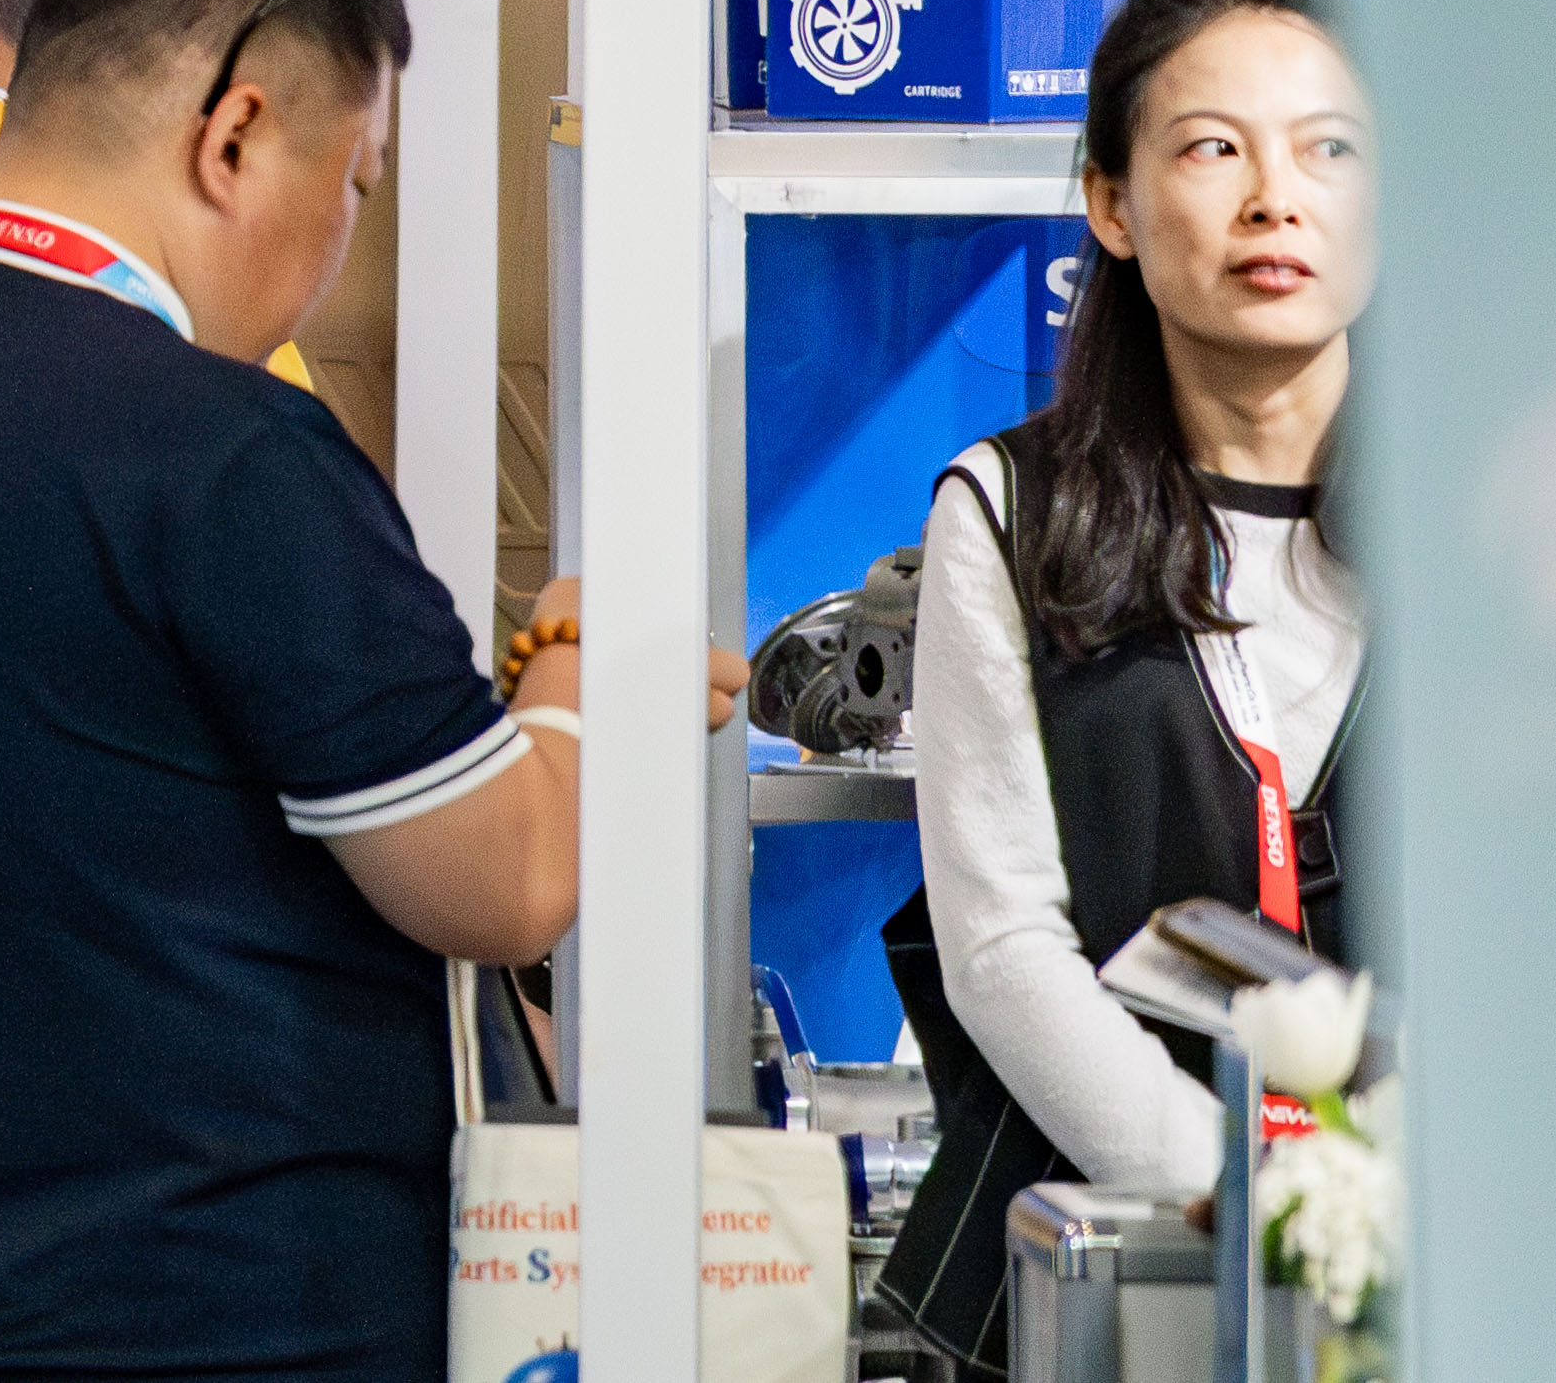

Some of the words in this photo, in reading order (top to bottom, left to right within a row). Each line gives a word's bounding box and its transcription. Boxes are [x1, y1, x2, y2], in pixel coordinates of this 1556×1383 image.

[904, 85, 962, 99] CARTRIDGE
[1261, 784, 1285, 868] DENSO
[702, 1261, 813, 1294] egrator
